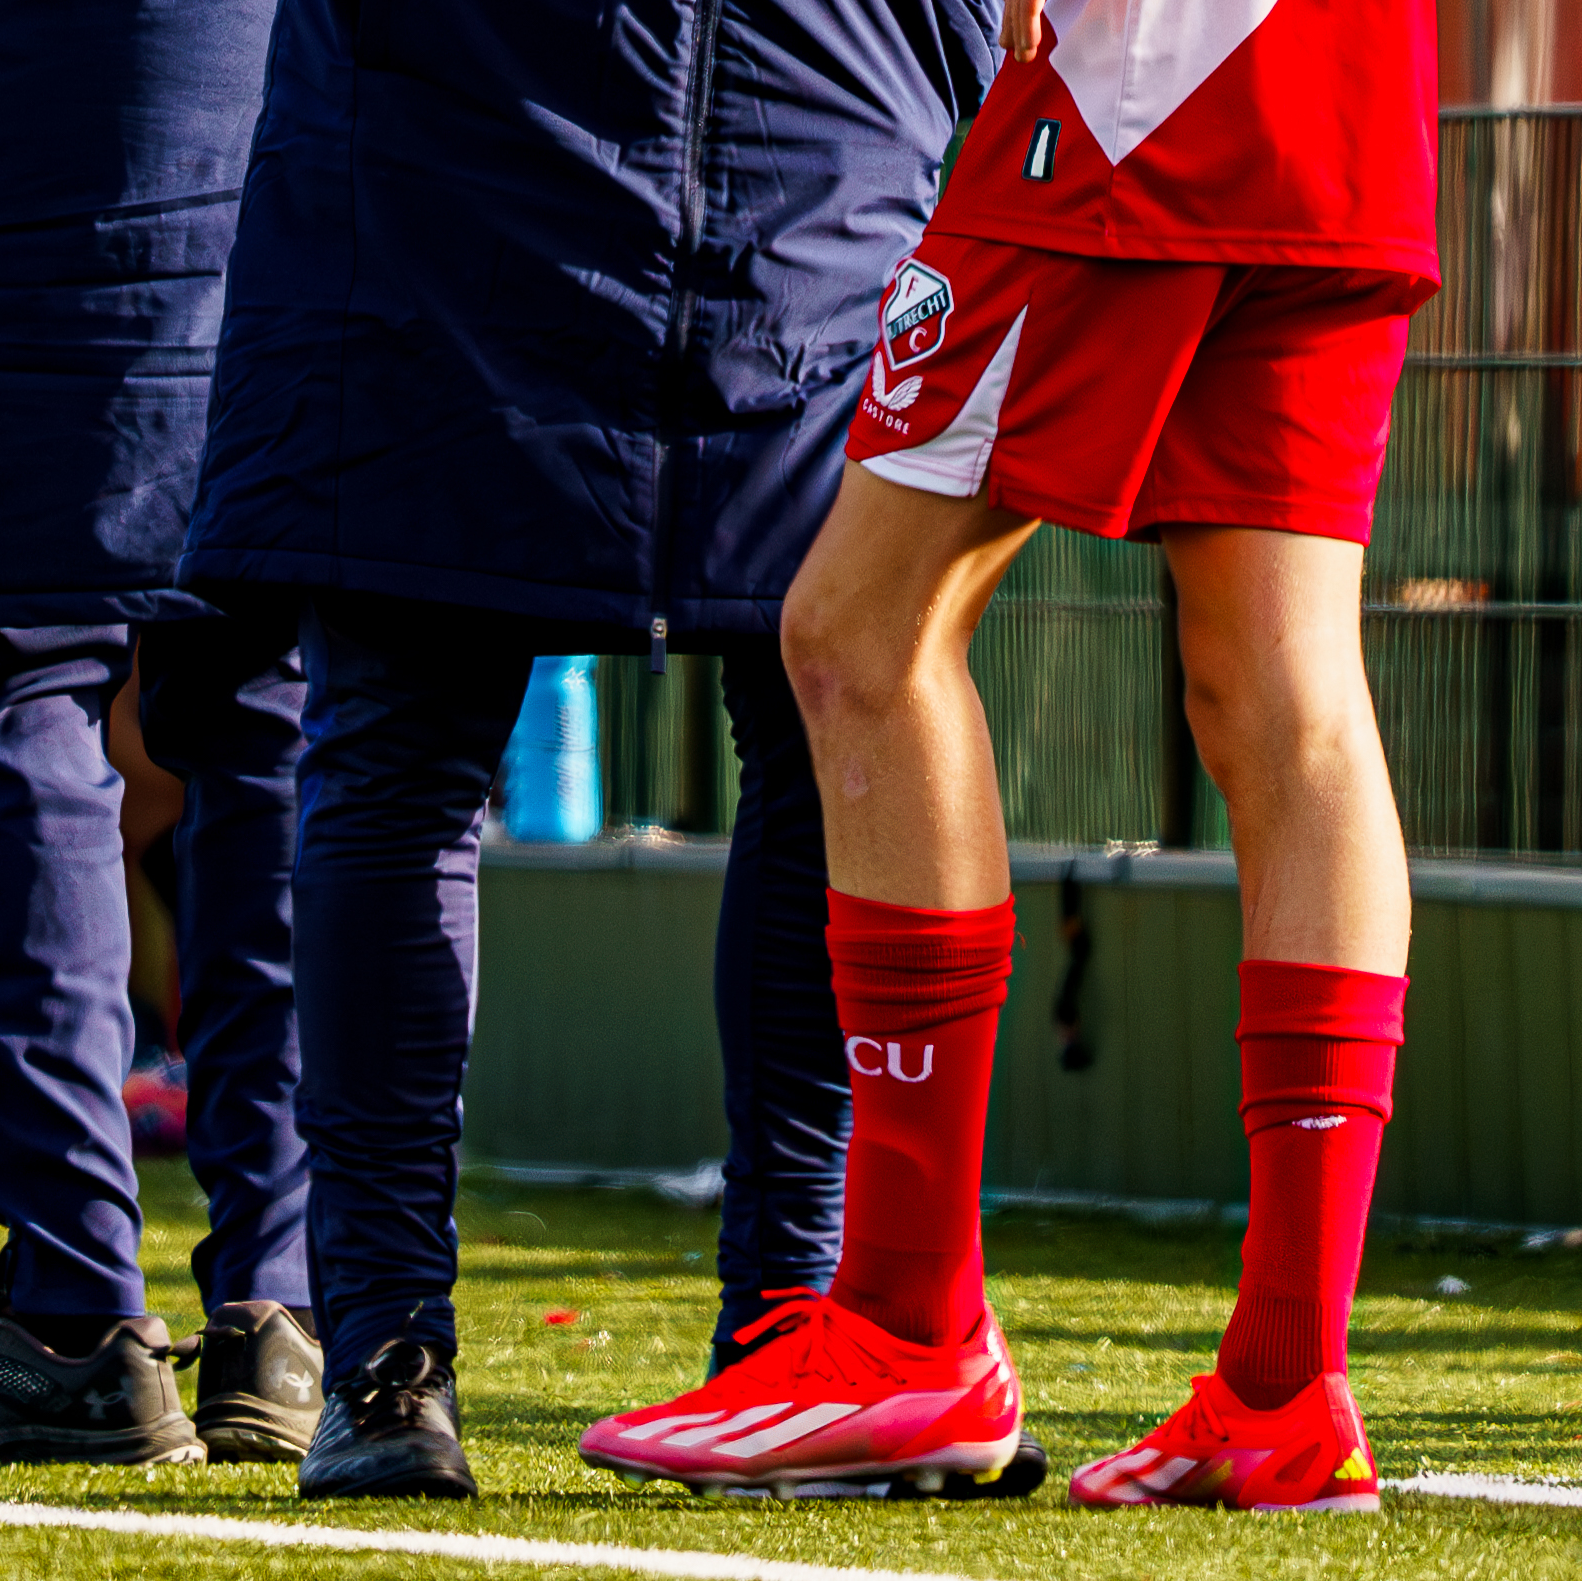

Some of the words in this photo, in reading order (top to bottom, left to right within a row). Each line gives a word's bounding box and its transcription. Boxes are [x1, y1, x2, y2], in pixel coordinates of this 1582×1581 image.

[905, 274, 919, 300] F
[887, 289, 947, 341] UTRECHT
[908, 326, 928, 354] C
[862, 397, 911, 436] CASTORE
